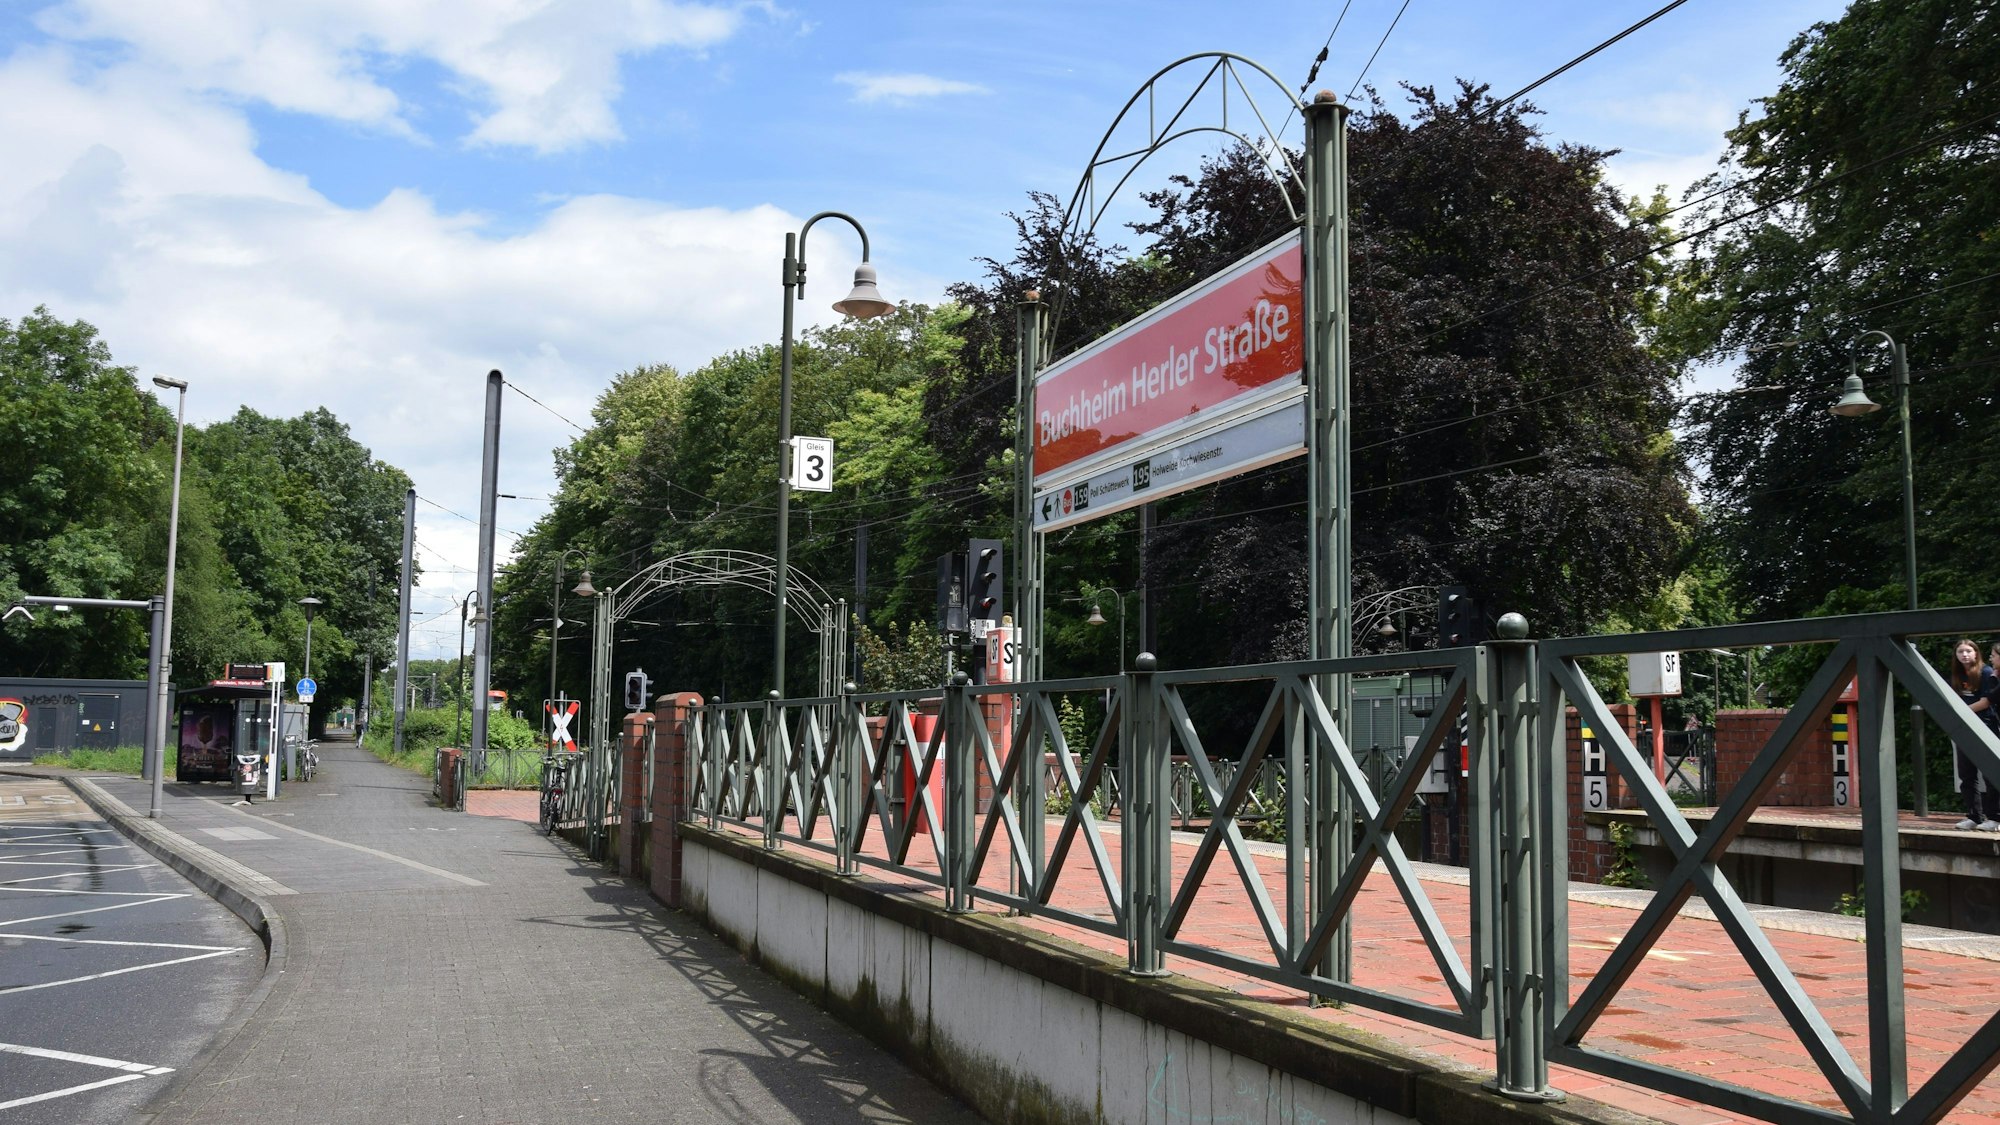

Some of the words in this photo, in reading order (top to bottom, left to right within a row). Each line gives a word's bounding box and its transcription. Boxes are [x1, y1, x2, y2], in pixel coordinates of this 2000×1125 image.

[1040, 380, 1126, 447] Buchheim
[1132, 345, 1199, 407] Herler
[1204, 299, 1289, 374] Straße
[806, 442, 825, 451] Gleis
[806, 454, 824, 482] 3
[1074, 487, 1088, 507] 159
[1090, 486, 1099, 498] Poll
[1100, 476, 1130, 496] Schüttewerk
[1133, 465, 1150, 487] 195
[1152, 461, 1179, 478] Holweide
[1665, 654, 1676, 672] SF
[1584, 741, 1606, 772] H
[1832, 744, 1849, 772] H
[1589, 781, 1603, 808] 5
[1836, 780, 1848, 806] 3
